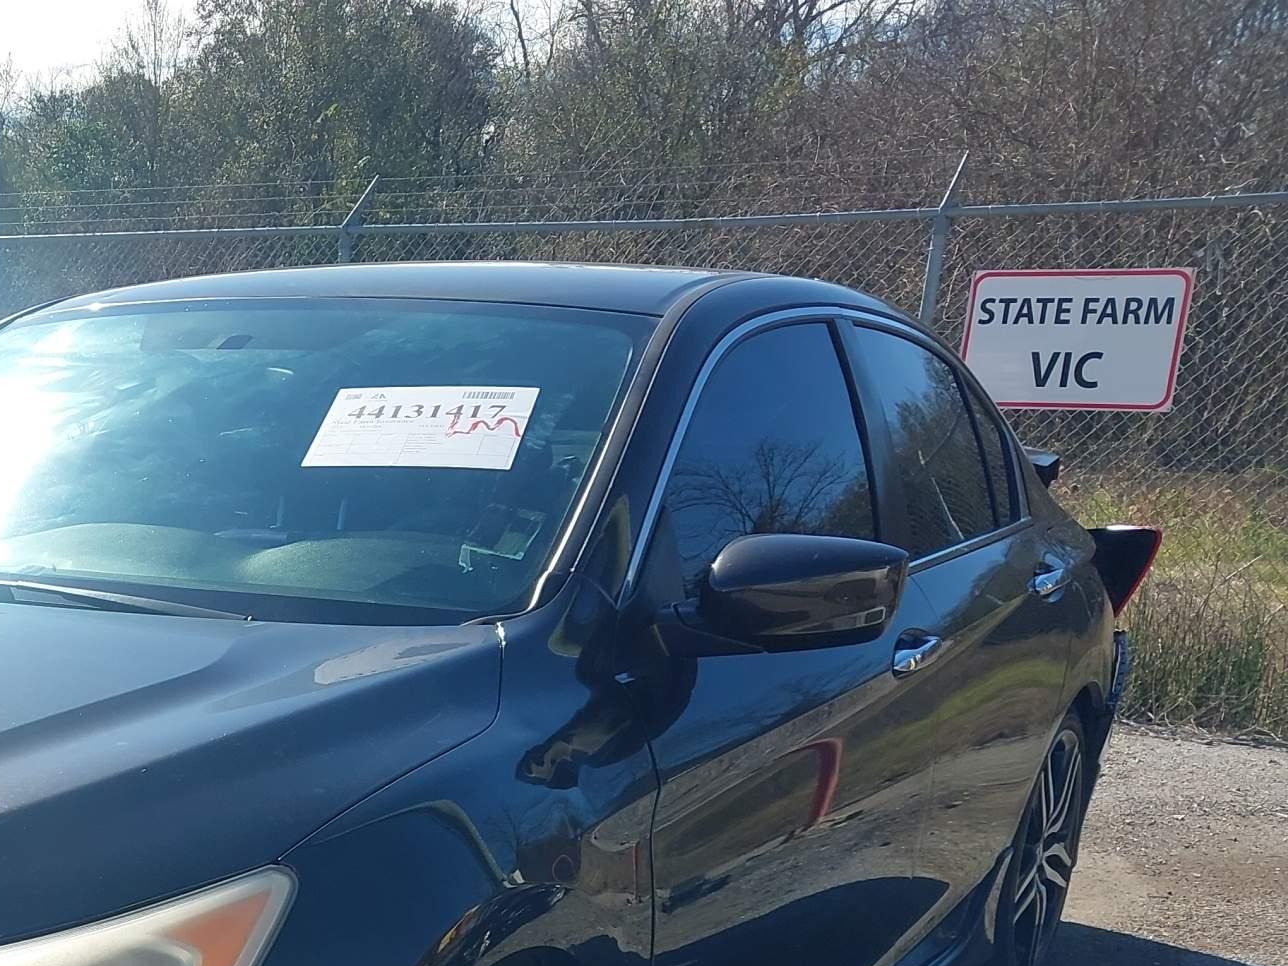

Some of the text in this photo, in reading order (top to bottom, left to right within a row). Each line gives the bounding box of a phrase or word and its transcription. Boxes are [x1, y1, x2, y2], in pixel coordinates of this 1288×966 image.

[977, 297, 1176, 325] STATE FARM
[1031, 351, 1104, 389] VIC
[347, 403, 508, 420] 44131417
